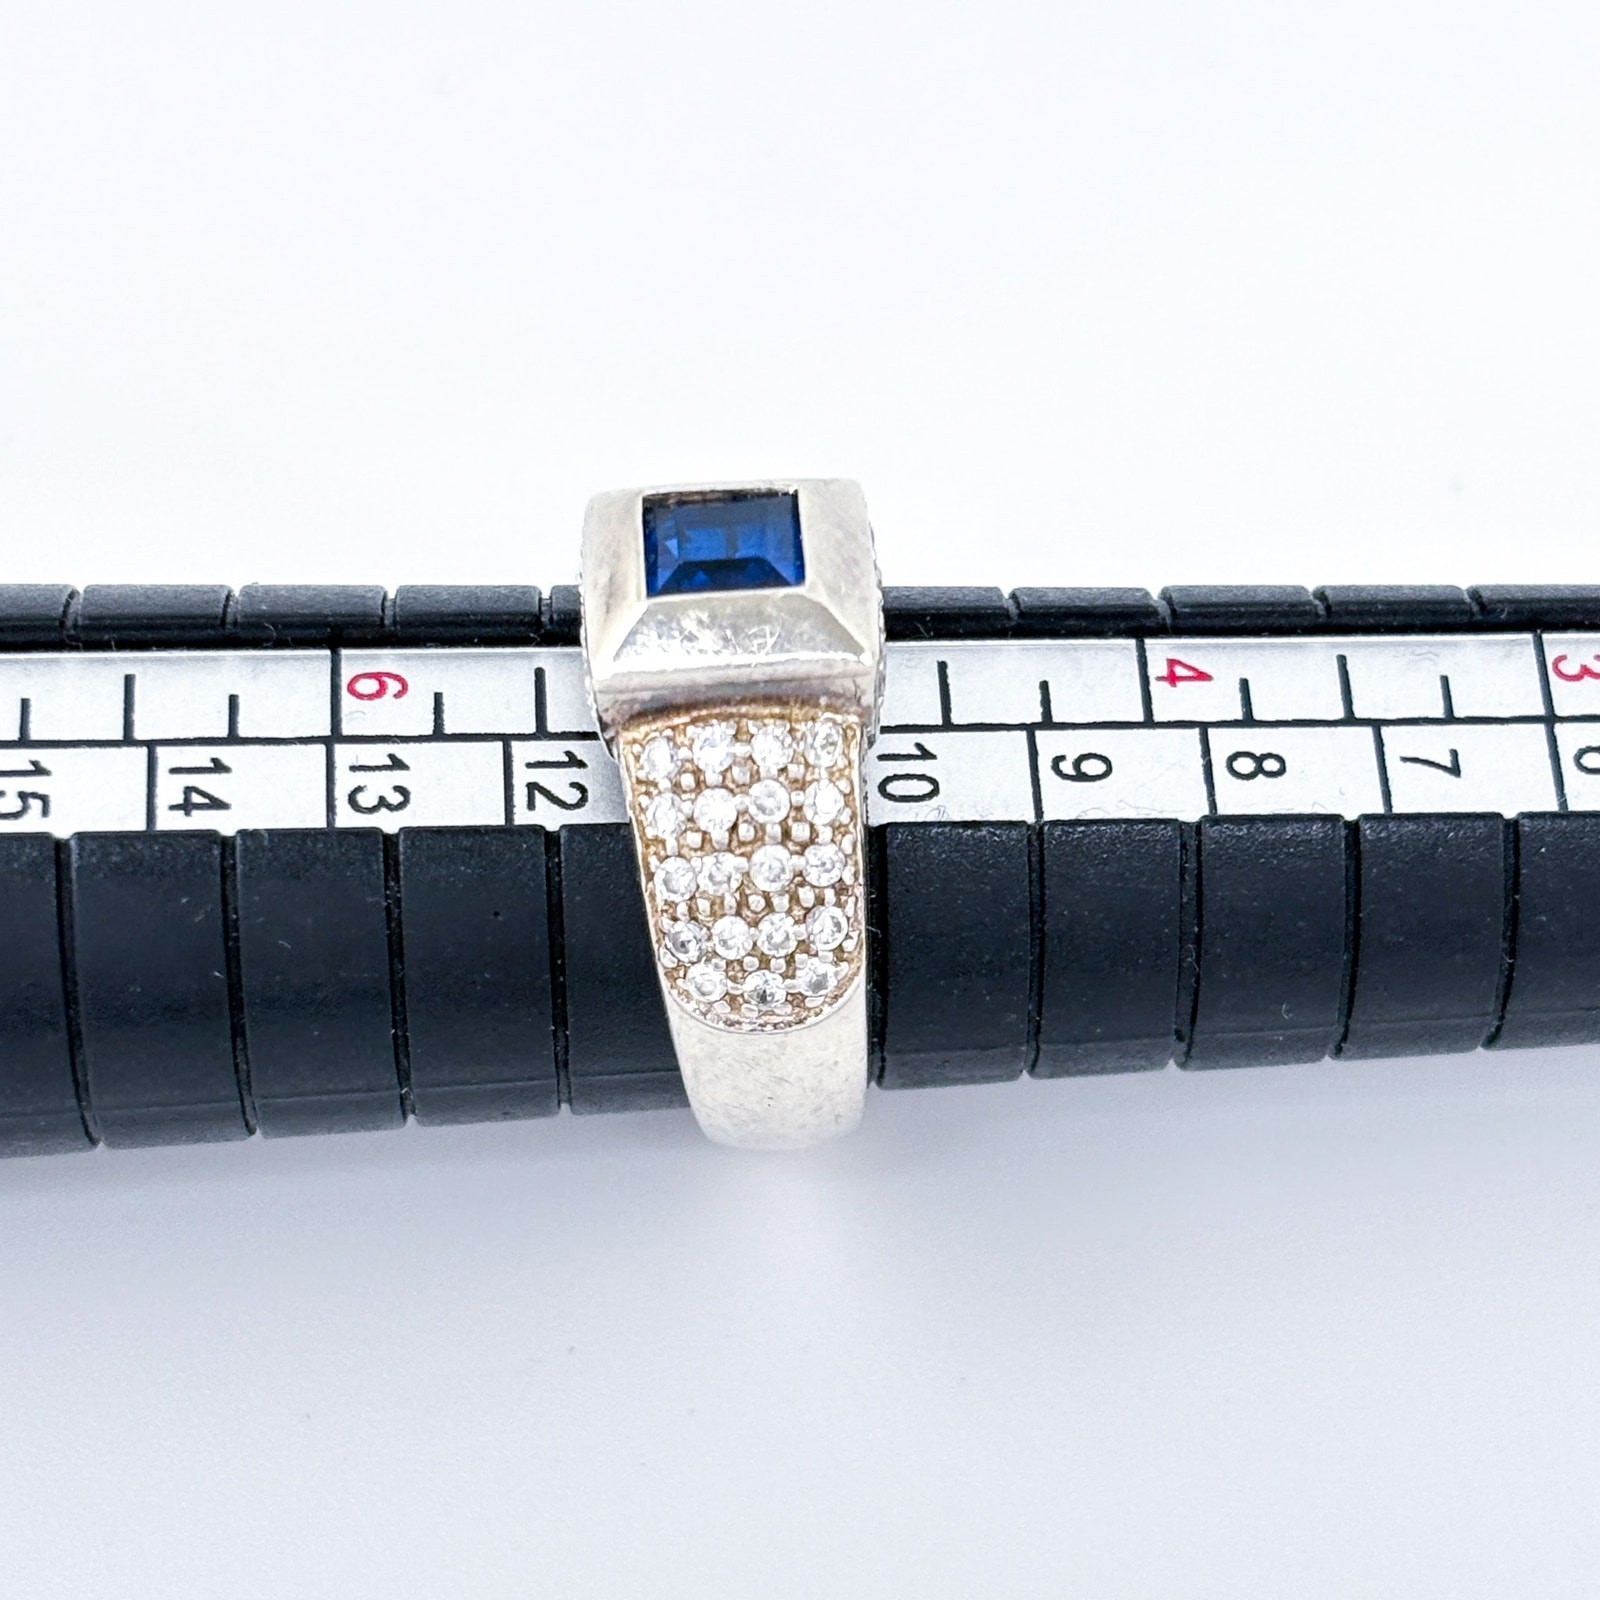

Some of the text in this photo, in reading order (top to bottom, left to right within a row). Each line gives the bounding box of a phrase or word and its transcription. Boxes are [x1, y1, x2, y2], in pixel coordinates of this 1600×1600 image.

[1154, 658, 1212, 688] 4
[1552, 656, 1600, 683] 3
[346, 671, 409, 702] 6
[876, 741, 940, 804] 10
[1051, 751, 1114, 784] 9
[1226, 750, 1288, 782] 8
[1400, 747, 1462, 779] 7
[0, 759, 52, 820] 15
[168, 756, 231, 818] 14
[347, 752, 411, 816] 13
[525, 749, 590, 812] 12
